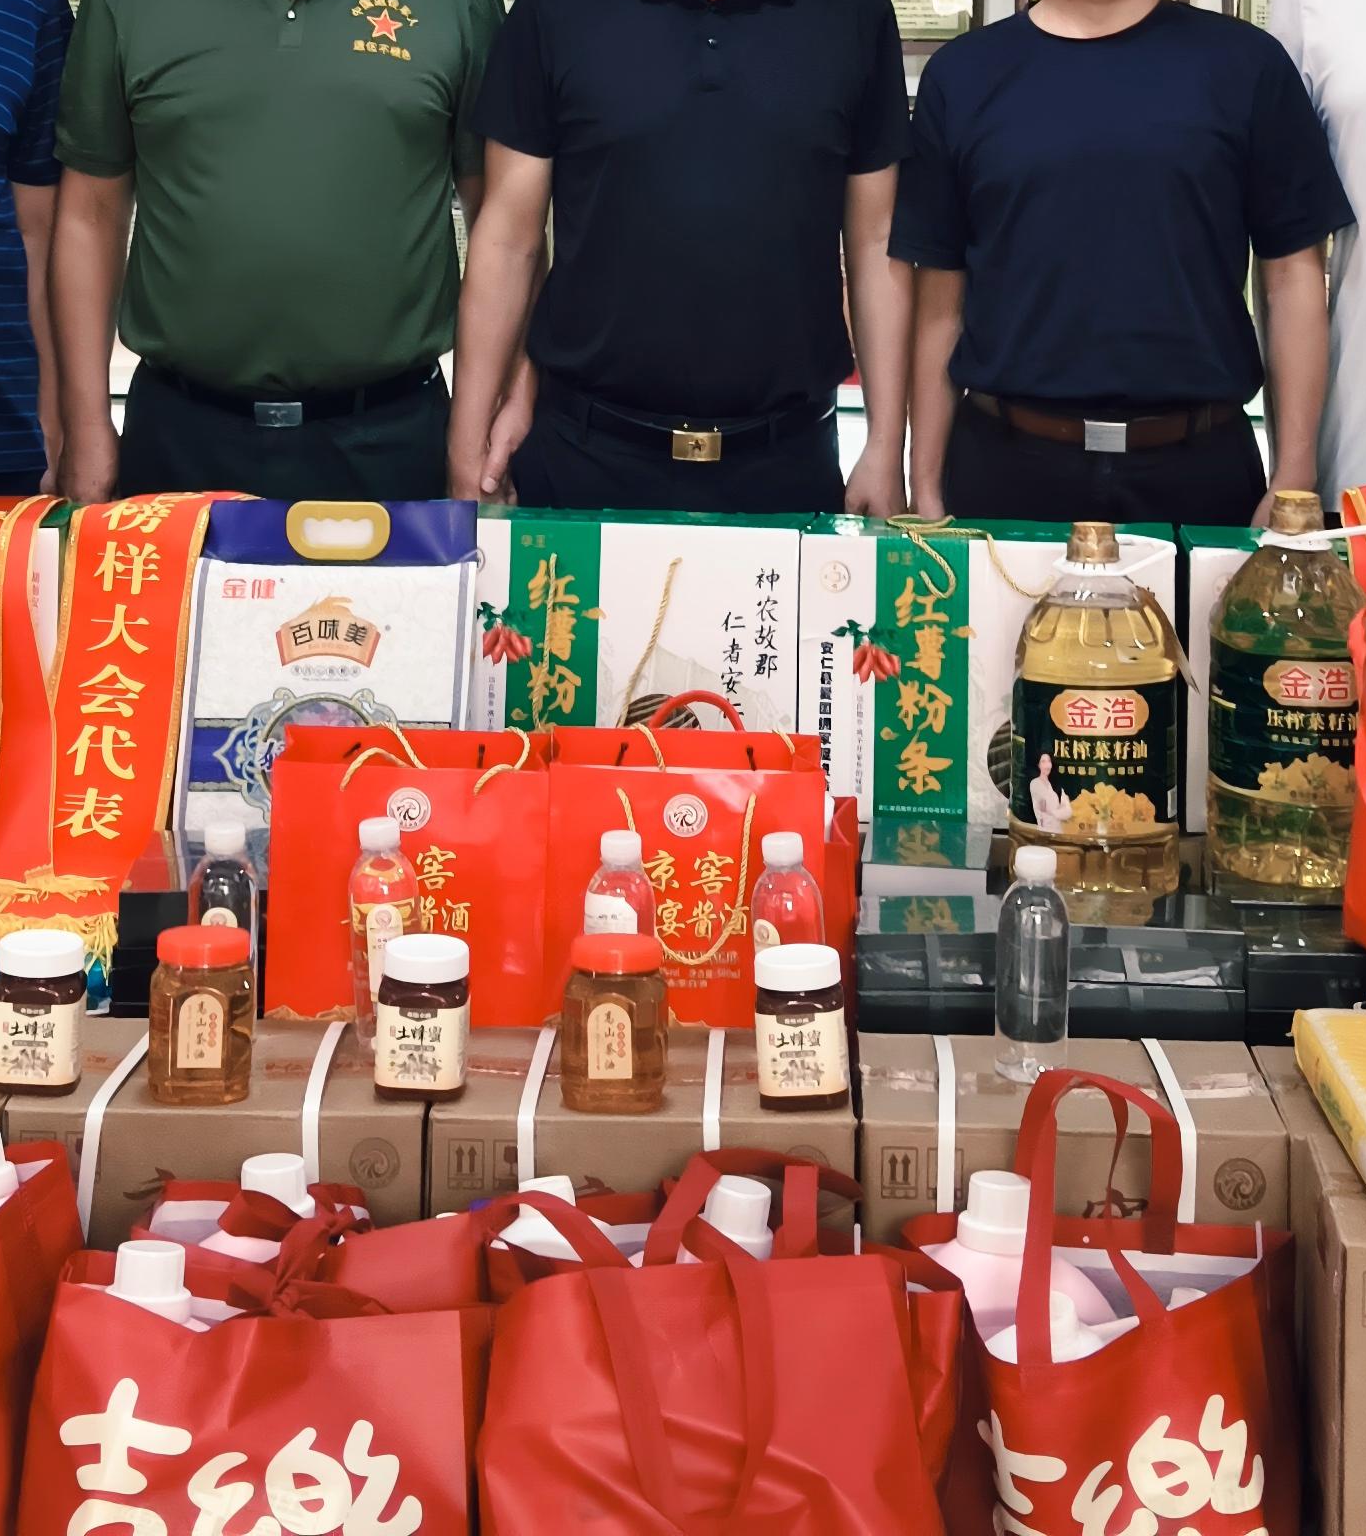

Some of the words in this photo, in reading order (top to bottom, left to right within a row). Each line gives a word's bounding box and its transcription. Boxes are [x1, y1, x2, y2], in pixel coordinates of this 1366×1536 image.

[221, 579, 277, 600] 金健
[290, 619, 369, 647] 百味美
[754, 568, 781, 680] 神农故郡
[527, 559, 583, 730] 红薯粉
[895, 576, 954, 795] 红薯粉条
[1280, 667, 1349, 701] 金浩
[1067, 697, 1135, 729] 金浩
[643, 849, 735, 896] 京窖
